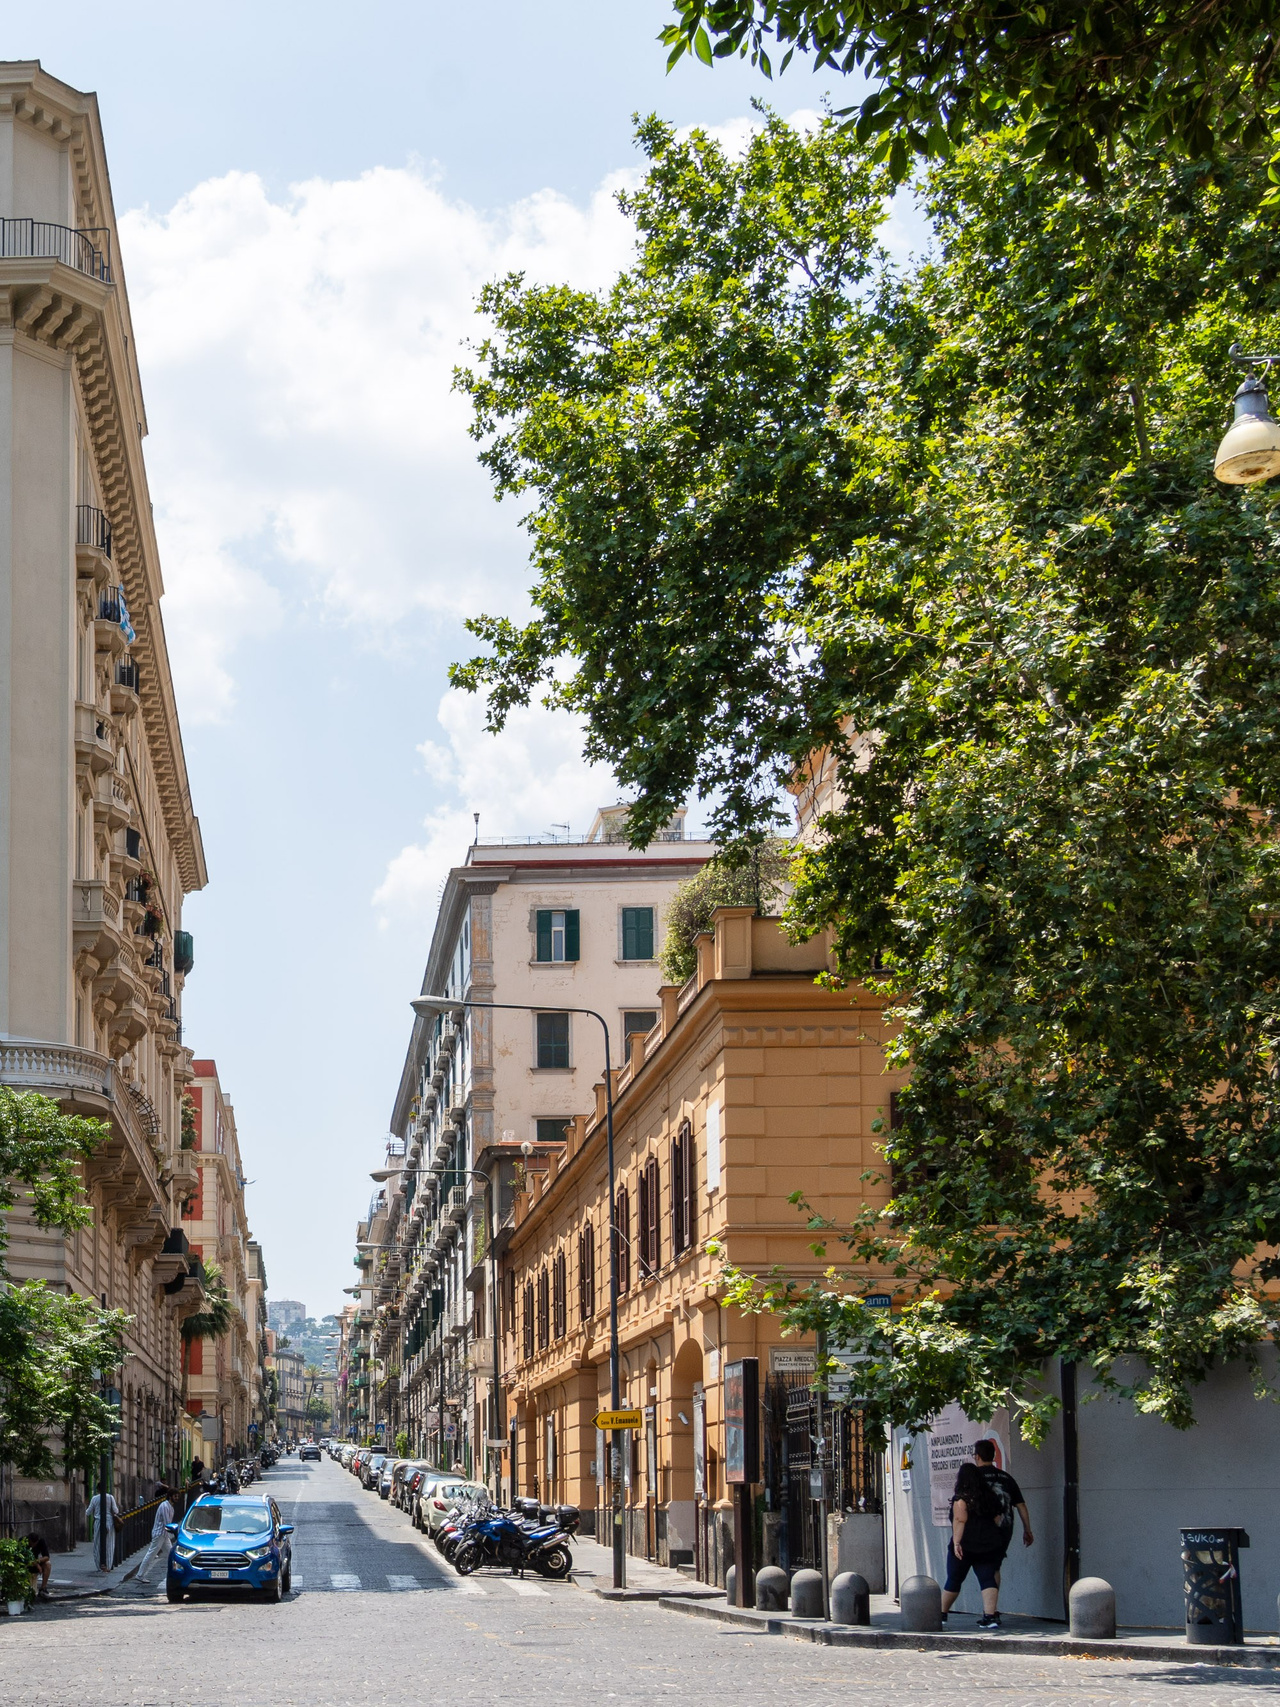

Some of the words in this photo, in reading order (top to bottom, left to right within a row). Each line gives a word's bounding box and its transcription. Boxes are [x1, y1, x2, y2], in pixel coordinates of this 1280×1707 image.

[866, 1296, 889, 1306] anm
[931, 1434, 959, 1446] AMPLIAMENTO
[932, 1446, 967, 1459] RIQUALIFICAZIONE
